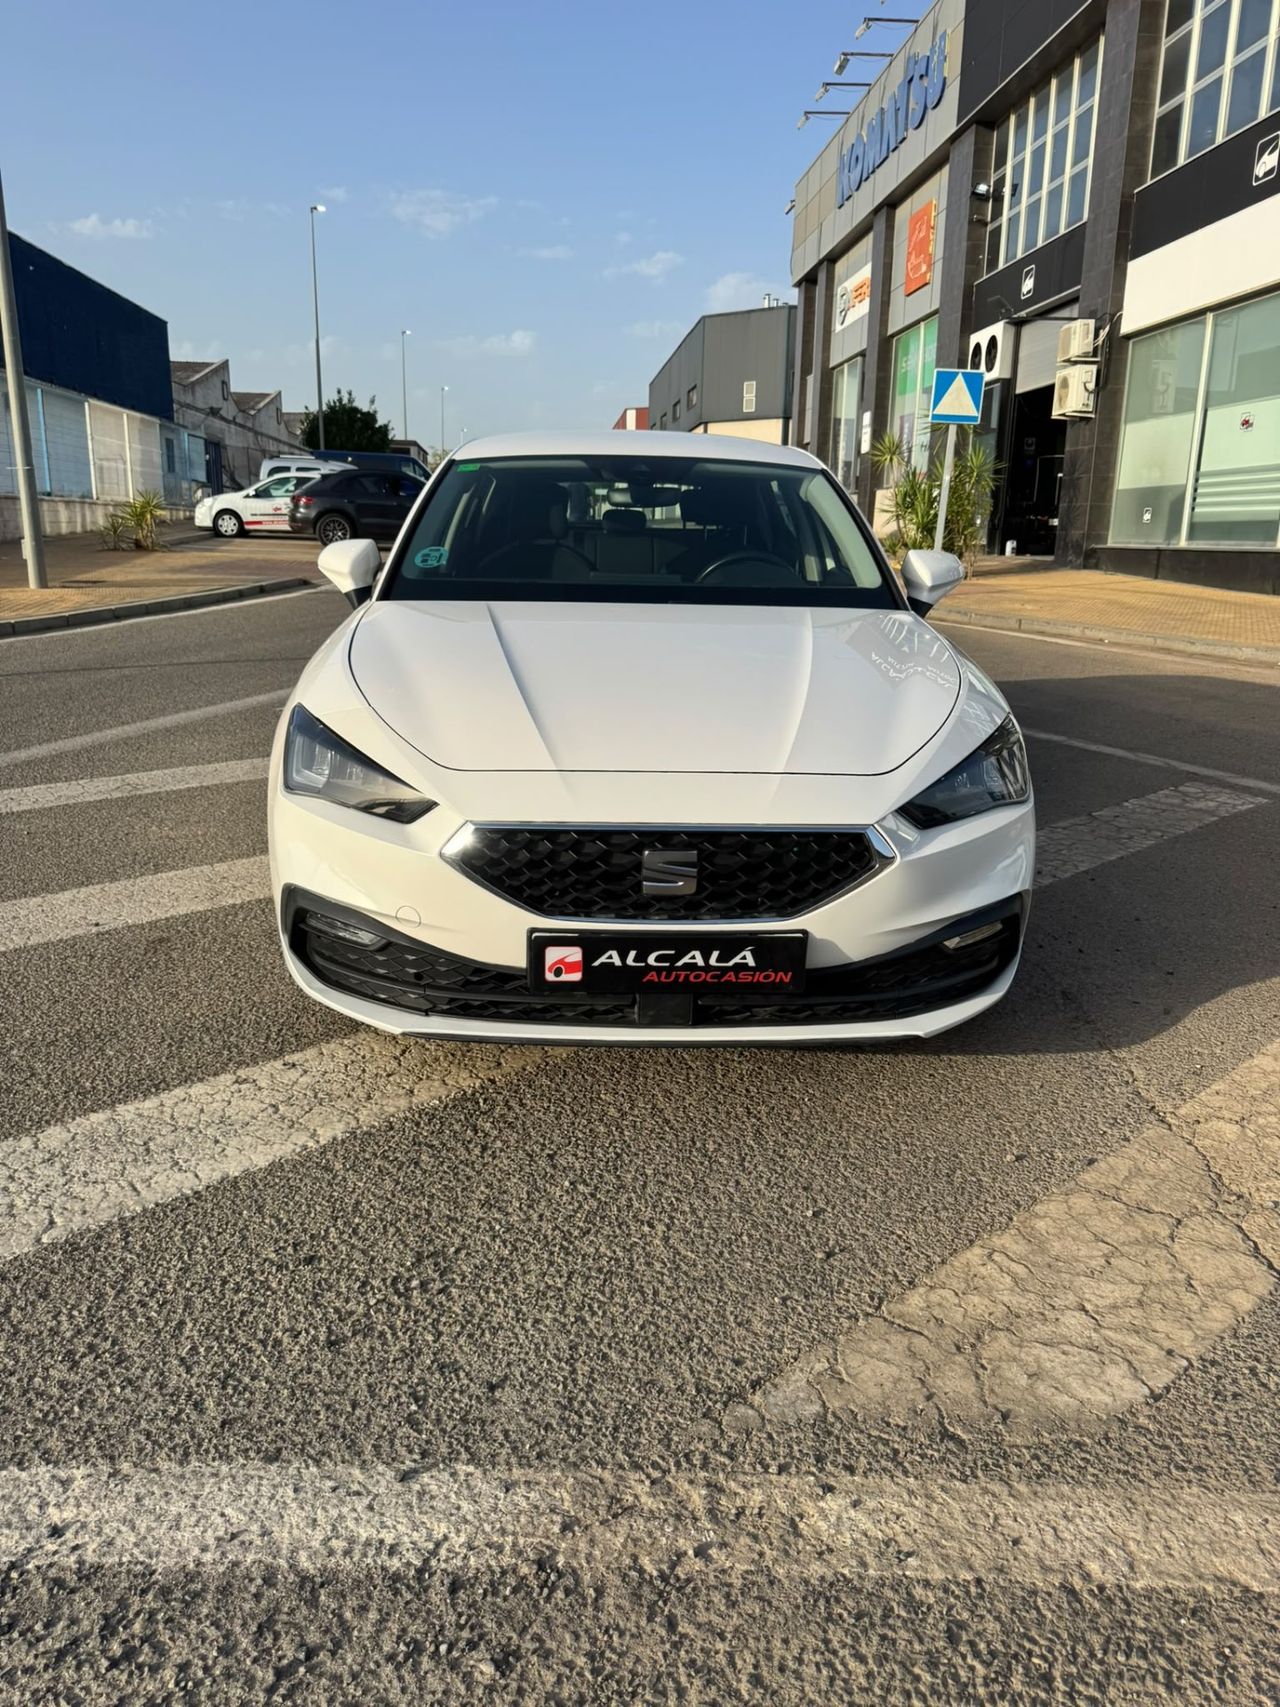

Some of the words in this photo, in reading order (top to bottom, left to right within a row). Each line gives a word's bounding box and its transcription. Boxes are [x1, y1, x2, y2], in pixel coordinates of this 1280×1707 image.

[836, 29, 947, 209] KOMATSU
[591, 946, 756, 967] ALCALÁ
[642, 968, 793, 983] AUTOCASIÓN
